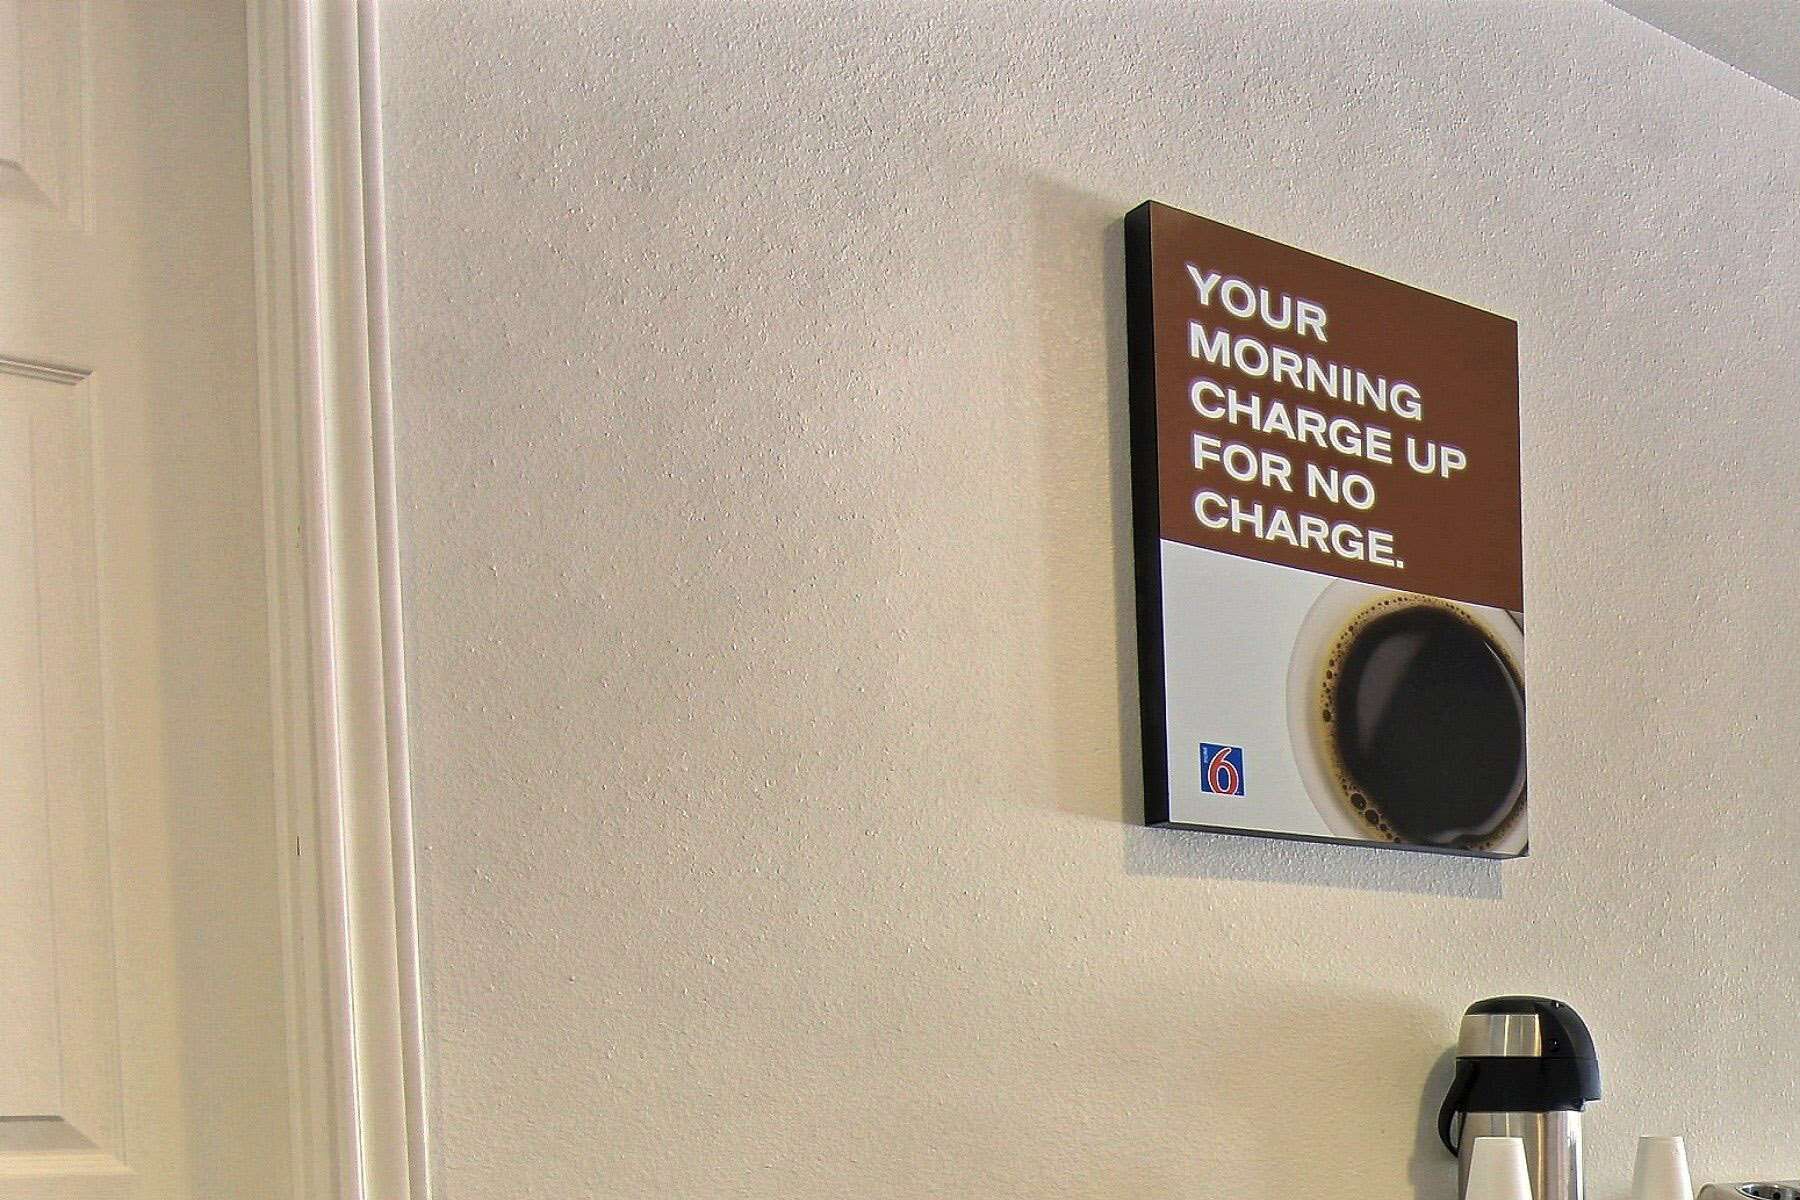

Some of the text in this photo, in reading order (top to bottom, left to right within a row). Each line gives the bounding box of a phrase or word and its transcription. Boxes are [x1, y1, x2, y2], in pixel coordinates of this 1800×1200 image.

[1186, 264, 1328, 343] YOUR
[1188, 321, 1423, 421] MORNING
[1190, 380, 1467, 480] CHARGE UP
[1192, 433, 1376, 511] FOR NO
[1193, 491, 1404, 569] CHARGE.
[1208, 748, 1239, 796] 6
